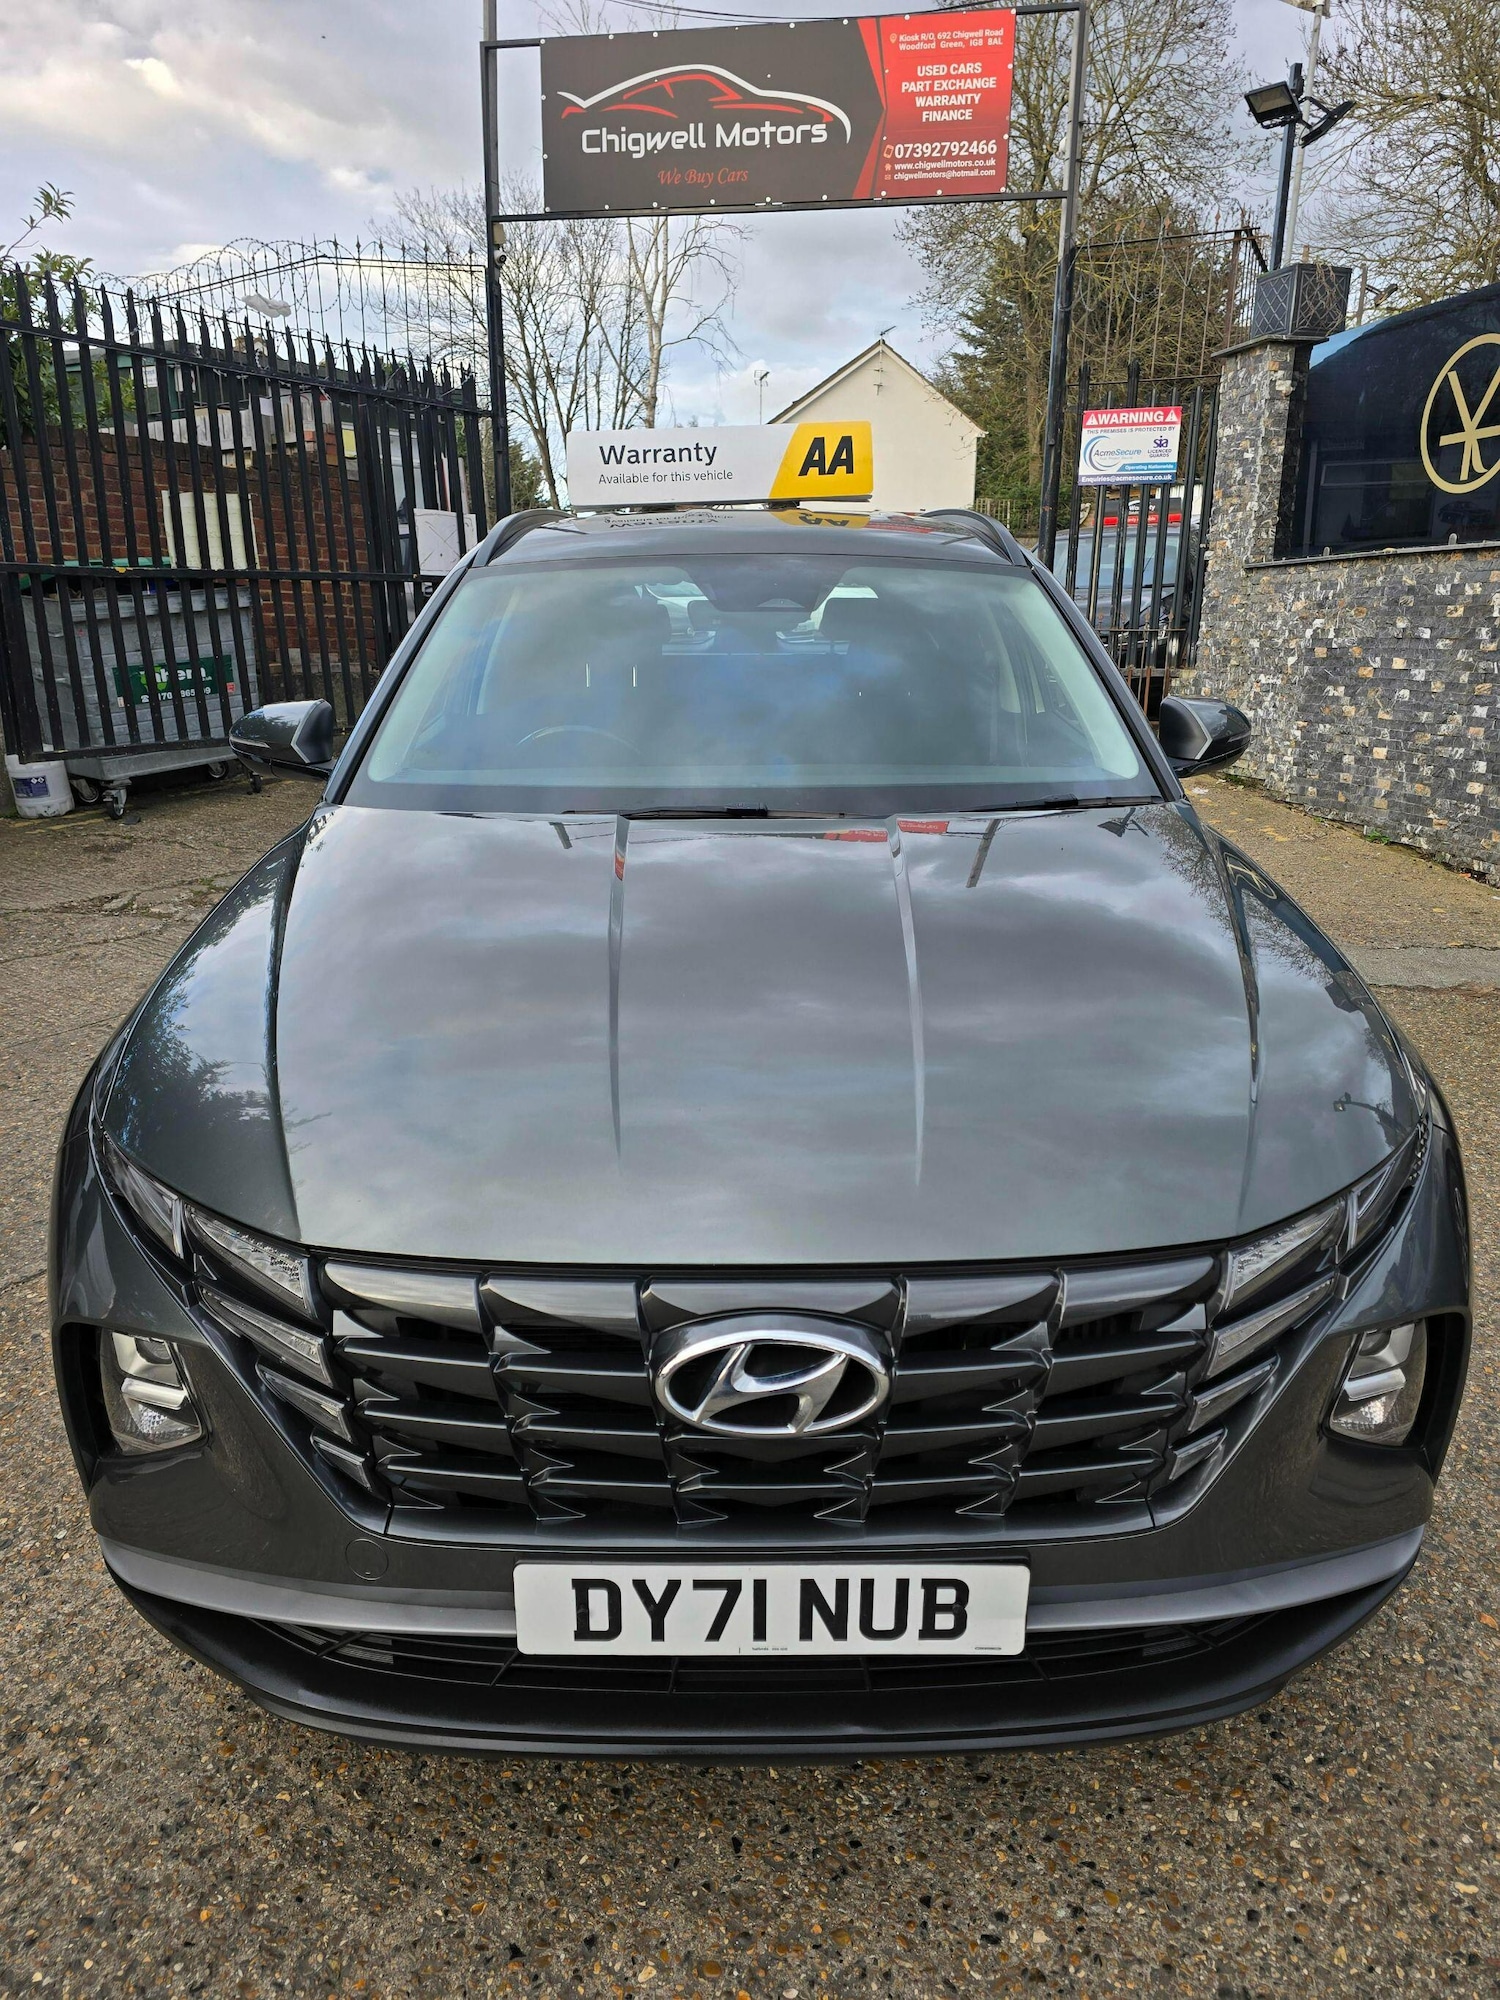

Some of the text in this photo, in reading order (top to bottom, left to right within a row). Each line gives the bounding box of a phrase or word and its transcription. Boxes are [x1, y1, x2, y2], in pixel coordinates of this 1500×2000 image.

[899, 34, 919, 42] Kiosk
[937, 31, 951, 40] 692
[953, 29, 983, 40] Chigwell
[985, 28, 1004, 37] Road
[899, 41, 936, 51] Woodford
[970, 38, 983, 47] IG8
[988, 37, 1003, 46] 8AL
[917, 62, 982, 77] USED CARS
[901, 77, 997, 93] PART EXCHANGE
[915, 93, 982, 107] WARRANTY
[922, 109, 973, 122] FINANCE
[581, 121, 828, 159] Chigwell Motors
[894, 140, 998, 158] 07392792466
[894, 157, 996, 171] www.chigwellmotors.co.uk
[657, 167, 749, 188] We Buy Cars
[894, 169, 996, 181] chigwellmotors@hotmail.com
[1098, 411, 1164, 425] WARNING
[598, 442, 718, 466] Warranty
[797, 435, 854, 477] AA
[1093, 448, 1142, 457] AcmeSecure
[598, 469, 733, 485] Available for this vehicle
[1081, 474, 1172, 483] Enquiries@acmesecure.co.uk
[570, 1577, 970, 1642] DY71 NUB
